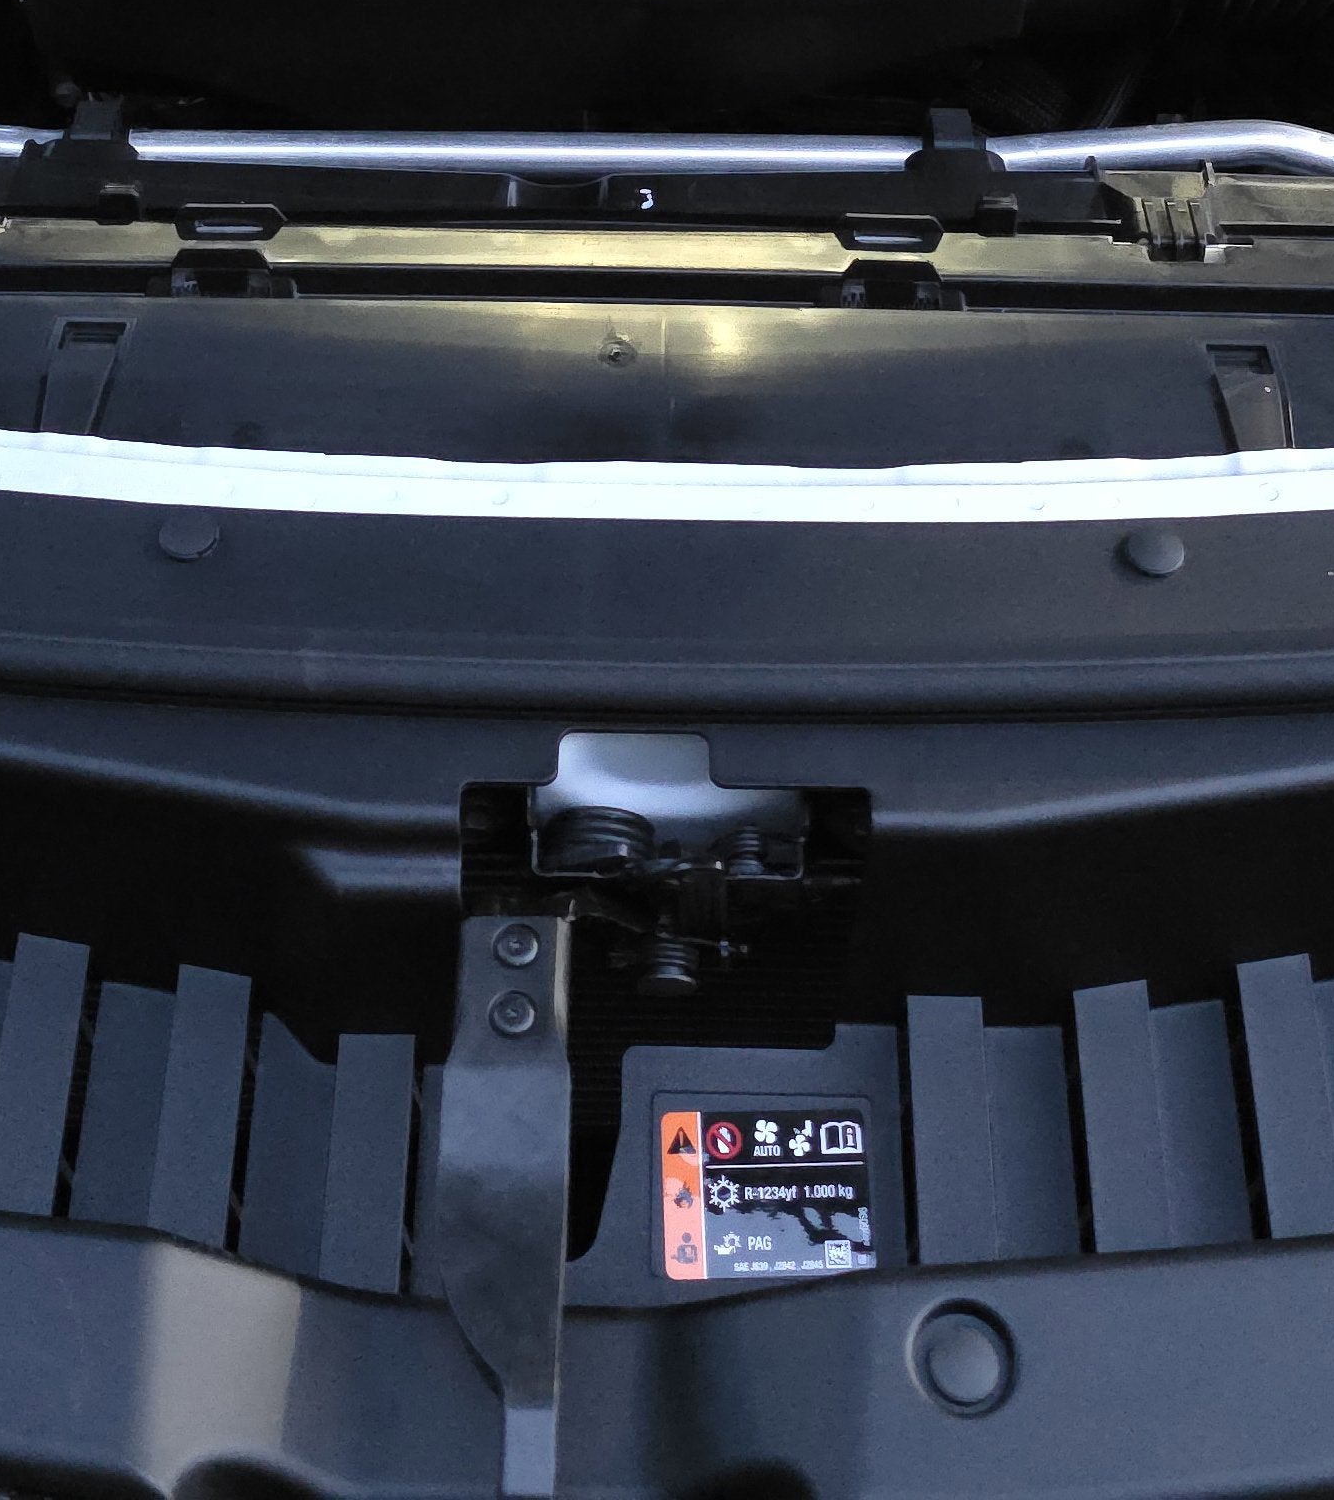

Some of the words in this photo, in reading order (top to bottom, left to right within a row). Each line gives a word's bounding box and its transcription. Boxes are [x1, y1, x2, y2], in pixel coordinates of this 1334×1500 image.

[753, 1145, 781, 1157] AUTO
[744, 1185, 797, 1201] R-1234yf
[803, 1184, 836, 1198] 1.000
[838, 1183, 854, 1200] kg
[747, 1235, 772, 1251] PAG
